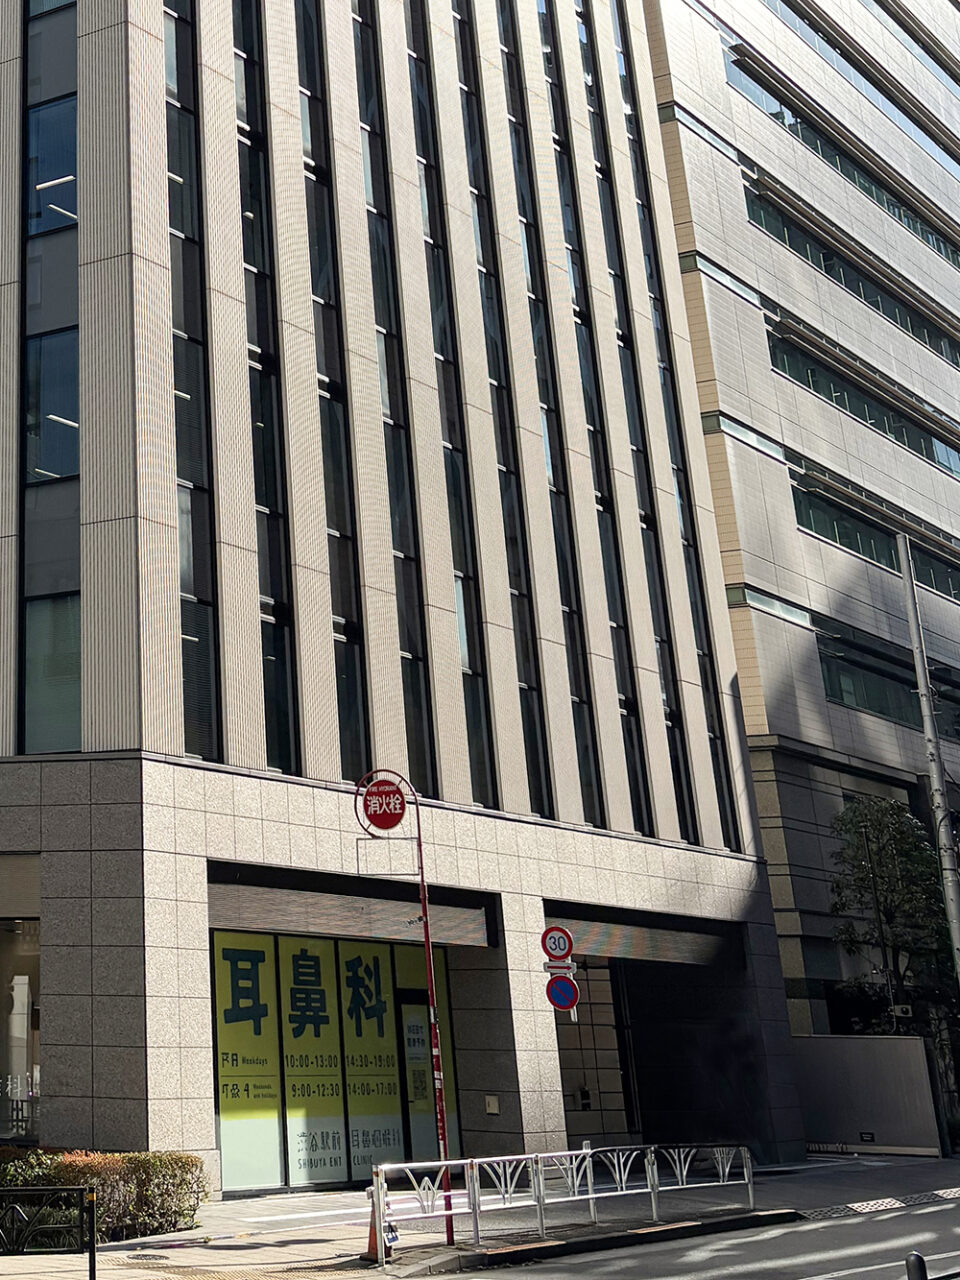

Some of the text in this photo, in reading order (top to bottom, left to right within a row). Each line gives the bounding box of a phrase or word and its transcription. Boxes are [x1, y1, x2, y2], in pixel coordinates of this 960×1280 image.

[367, 794, 402, 815] 消火栓
[548, 936, 567, 952] 30
[222, 947, 387, 1039] 耳鼻科
[285, 1054, 338, 1068] 10:00-13:00
[292, 1083, 339, 1097] 9:00-12:30
[298, 1154, 373, 1169] SHIBUYA ENT CLINIC
